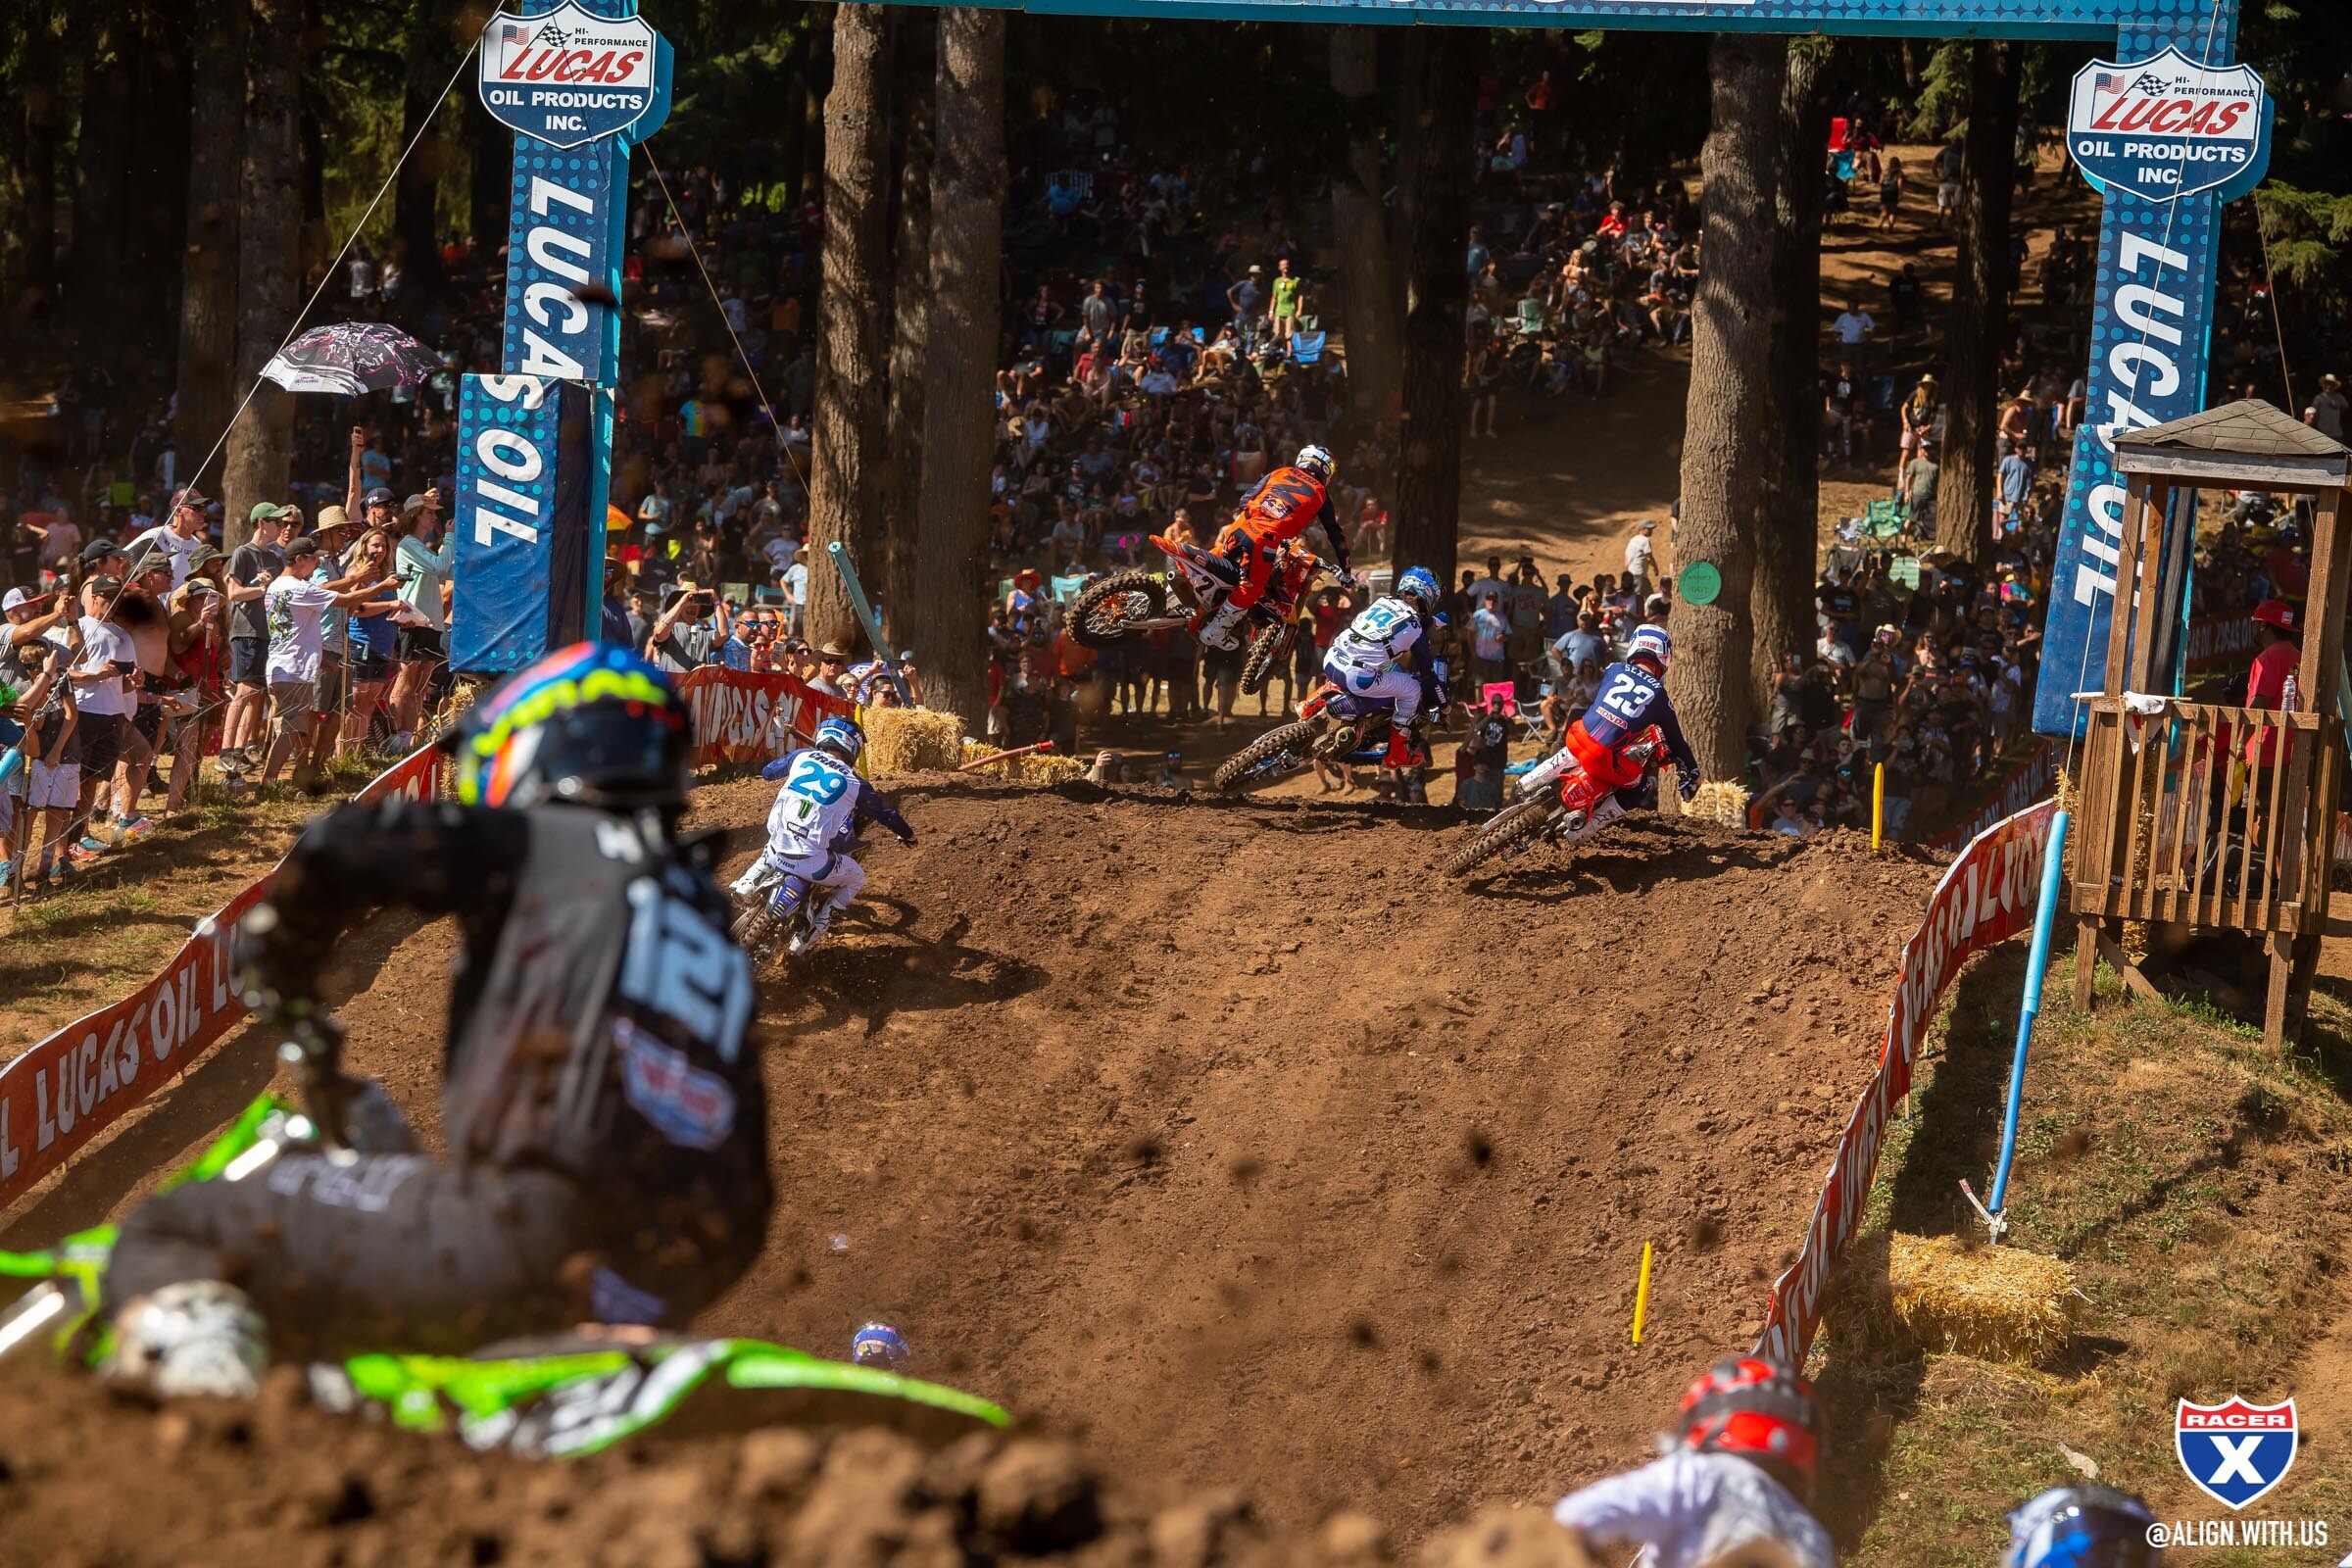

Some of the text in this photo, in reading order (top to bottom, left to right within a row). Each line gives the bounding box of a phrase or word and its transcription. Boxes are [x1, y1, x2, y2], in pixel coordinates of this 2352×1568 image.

[574, 26, 589, 35] HI-
[574, 37, 649, 47] PERFORMANCE
[500, 48, 644, 83] LUCAS
[2175, 75, 2190, 84] HI-
[490, 90, 643, 110] OIL PRODUCTS
[2174, 87, 2255, 97] PERFORMANCE
[545, 116, 587, 131] INC.
[2091, 97, 2250, 135] LUCAS
[2078, 140, 2246, 163] OIL PRODUCTS
[2137, 168, 2182, 184] INC.
[474, 175, 594, 547] LUCAS OIL
[1272, 475, 1315, 508] 2
[2074, 484, 2149, 607] OIL
[1195, 575, 1215, 598] 2
[1364, 607, 1395, 628] 14
[1624, 663, 1662, 689] SEXTON
[1434, 685, 1446, 704] THOR
[1602, 672, 1655, 718] 23
[1596, 707, 1628, 729] HONDA
[808, 752, 851, 775] CRAIG
[788, 760, 848, 806] 29
[776, 857, 797, 870] THOR
[35, 1003, 146, 1153] LUCAS
[150, 959, 202, 1061] OIL
